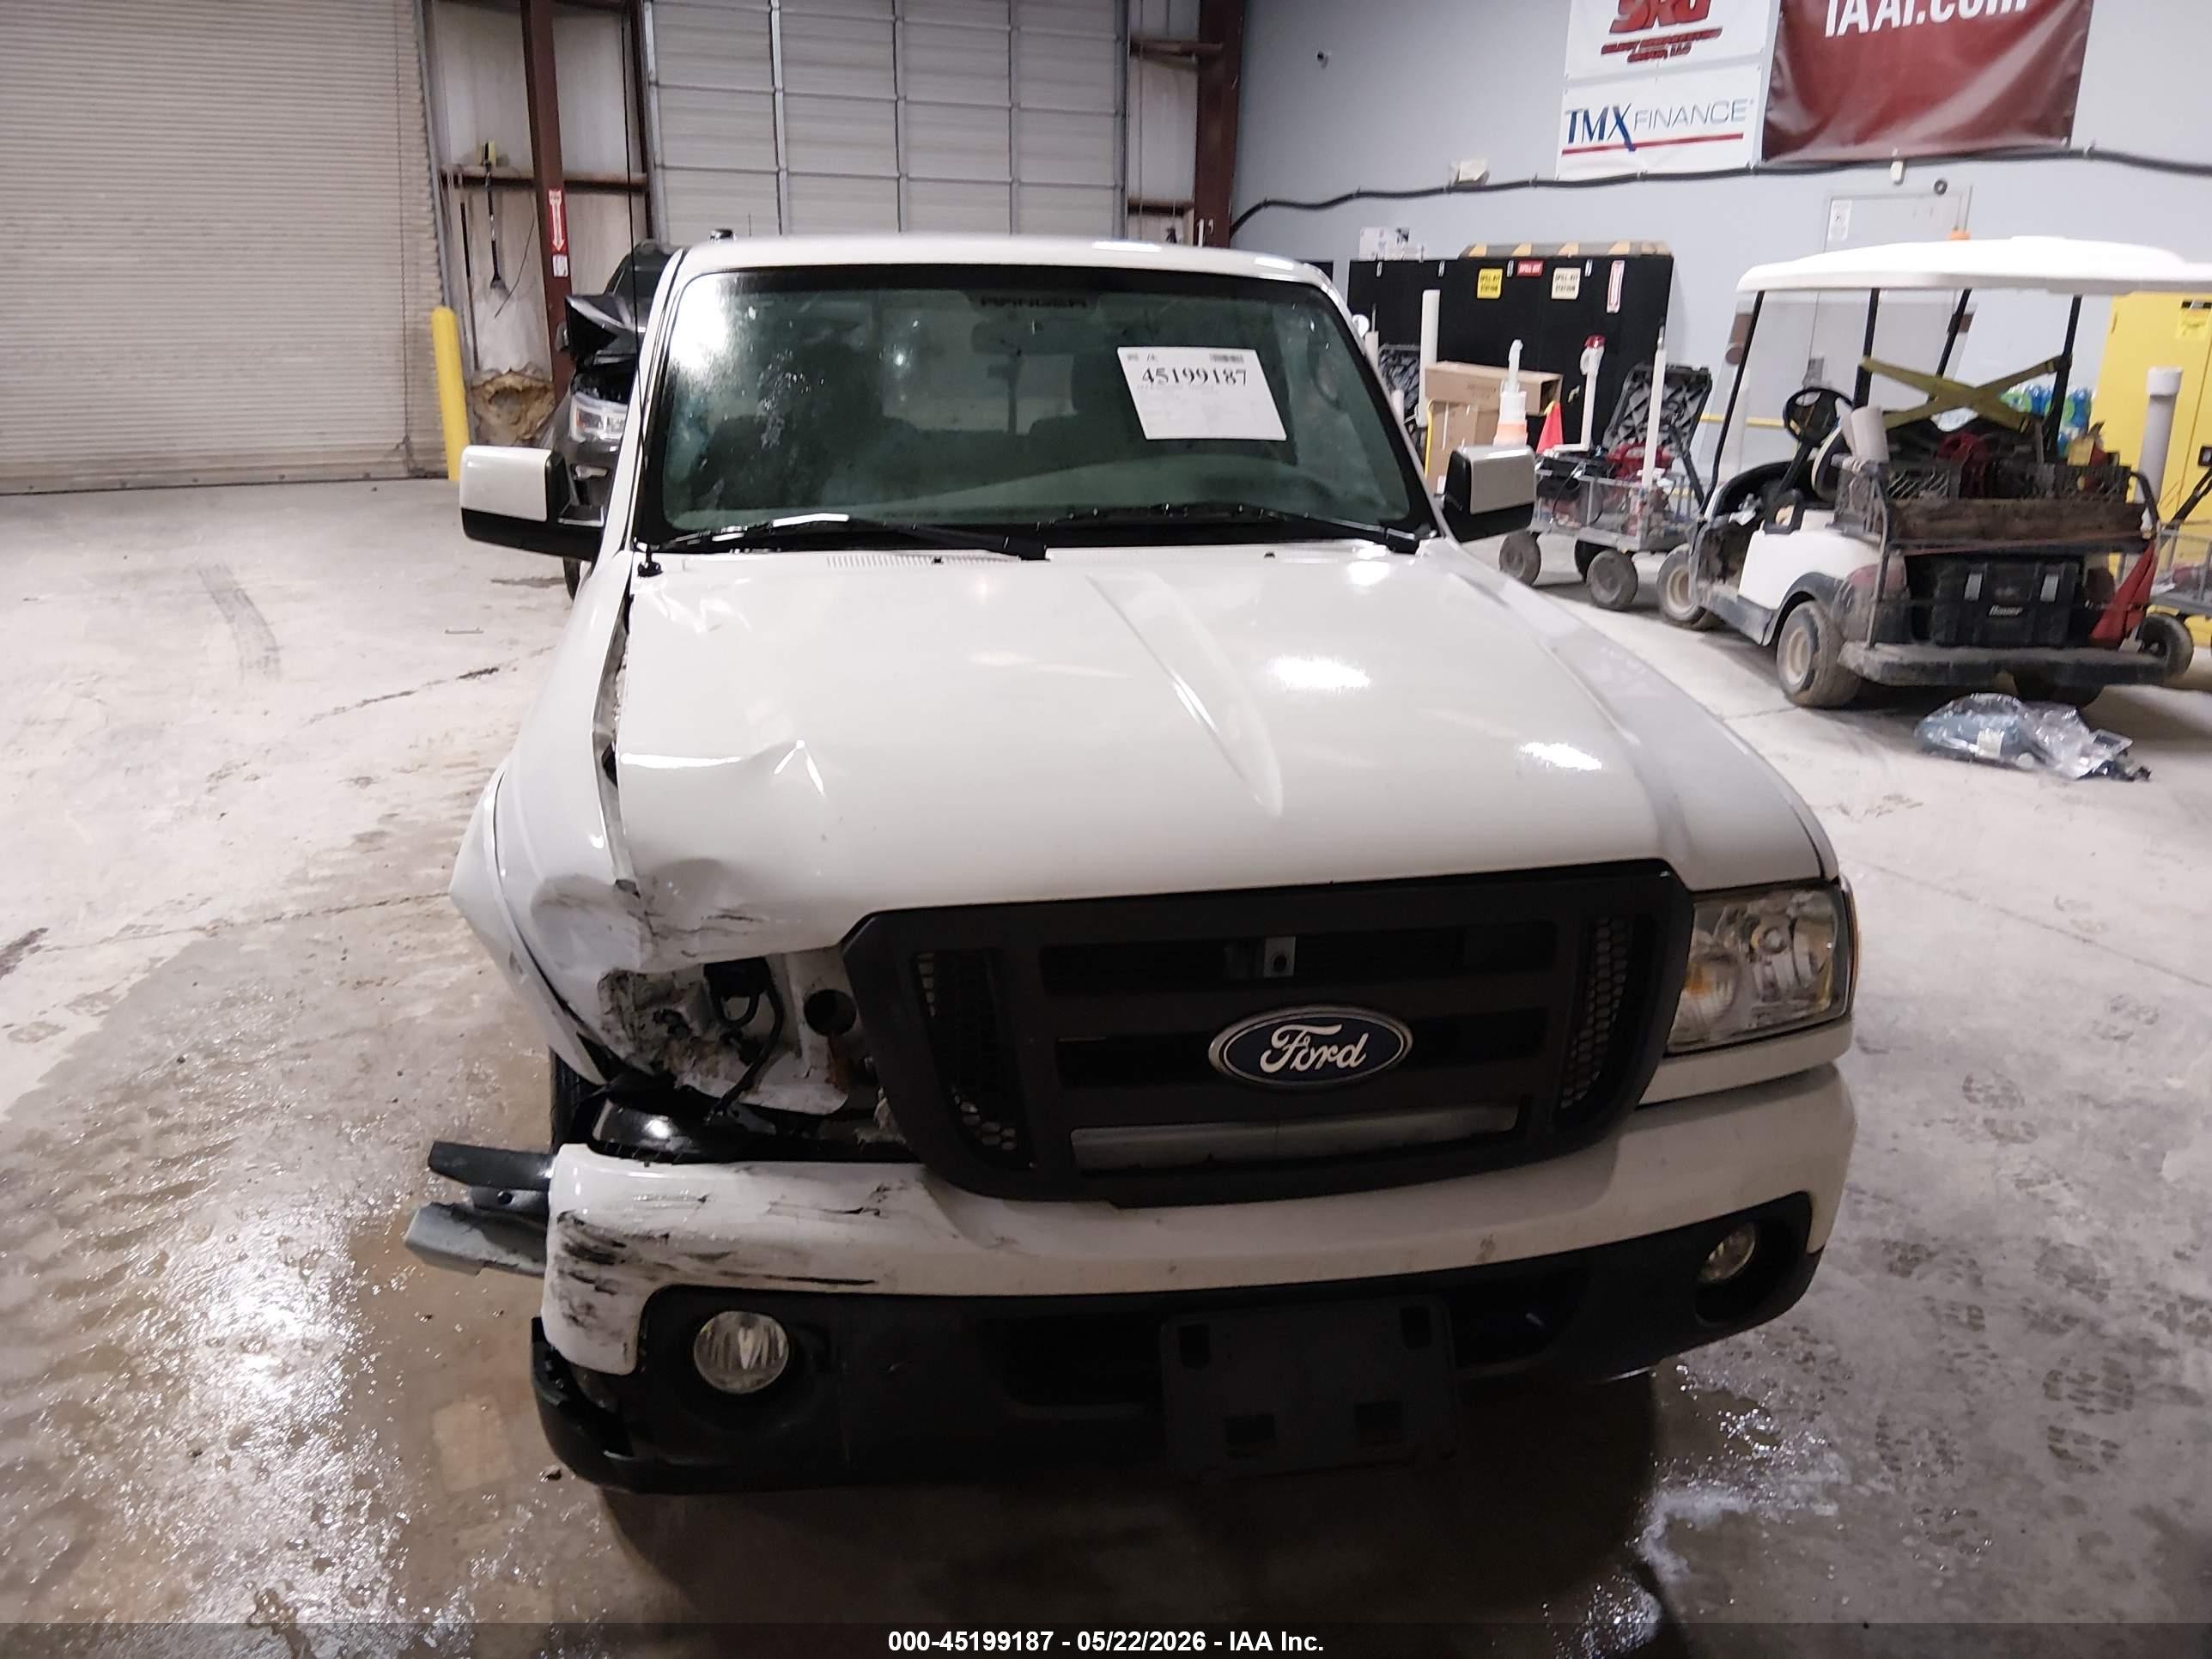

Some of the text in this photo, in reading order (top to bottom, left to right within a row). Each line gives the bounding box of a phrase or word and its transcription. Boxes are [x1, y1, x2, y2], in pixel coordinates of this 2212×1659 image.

[1565, 98, 1748, 152] TMX FINANCE
[1142, 367, 1247, 386] 45199187
[1260, 1024, 1369, 1073] Ford
